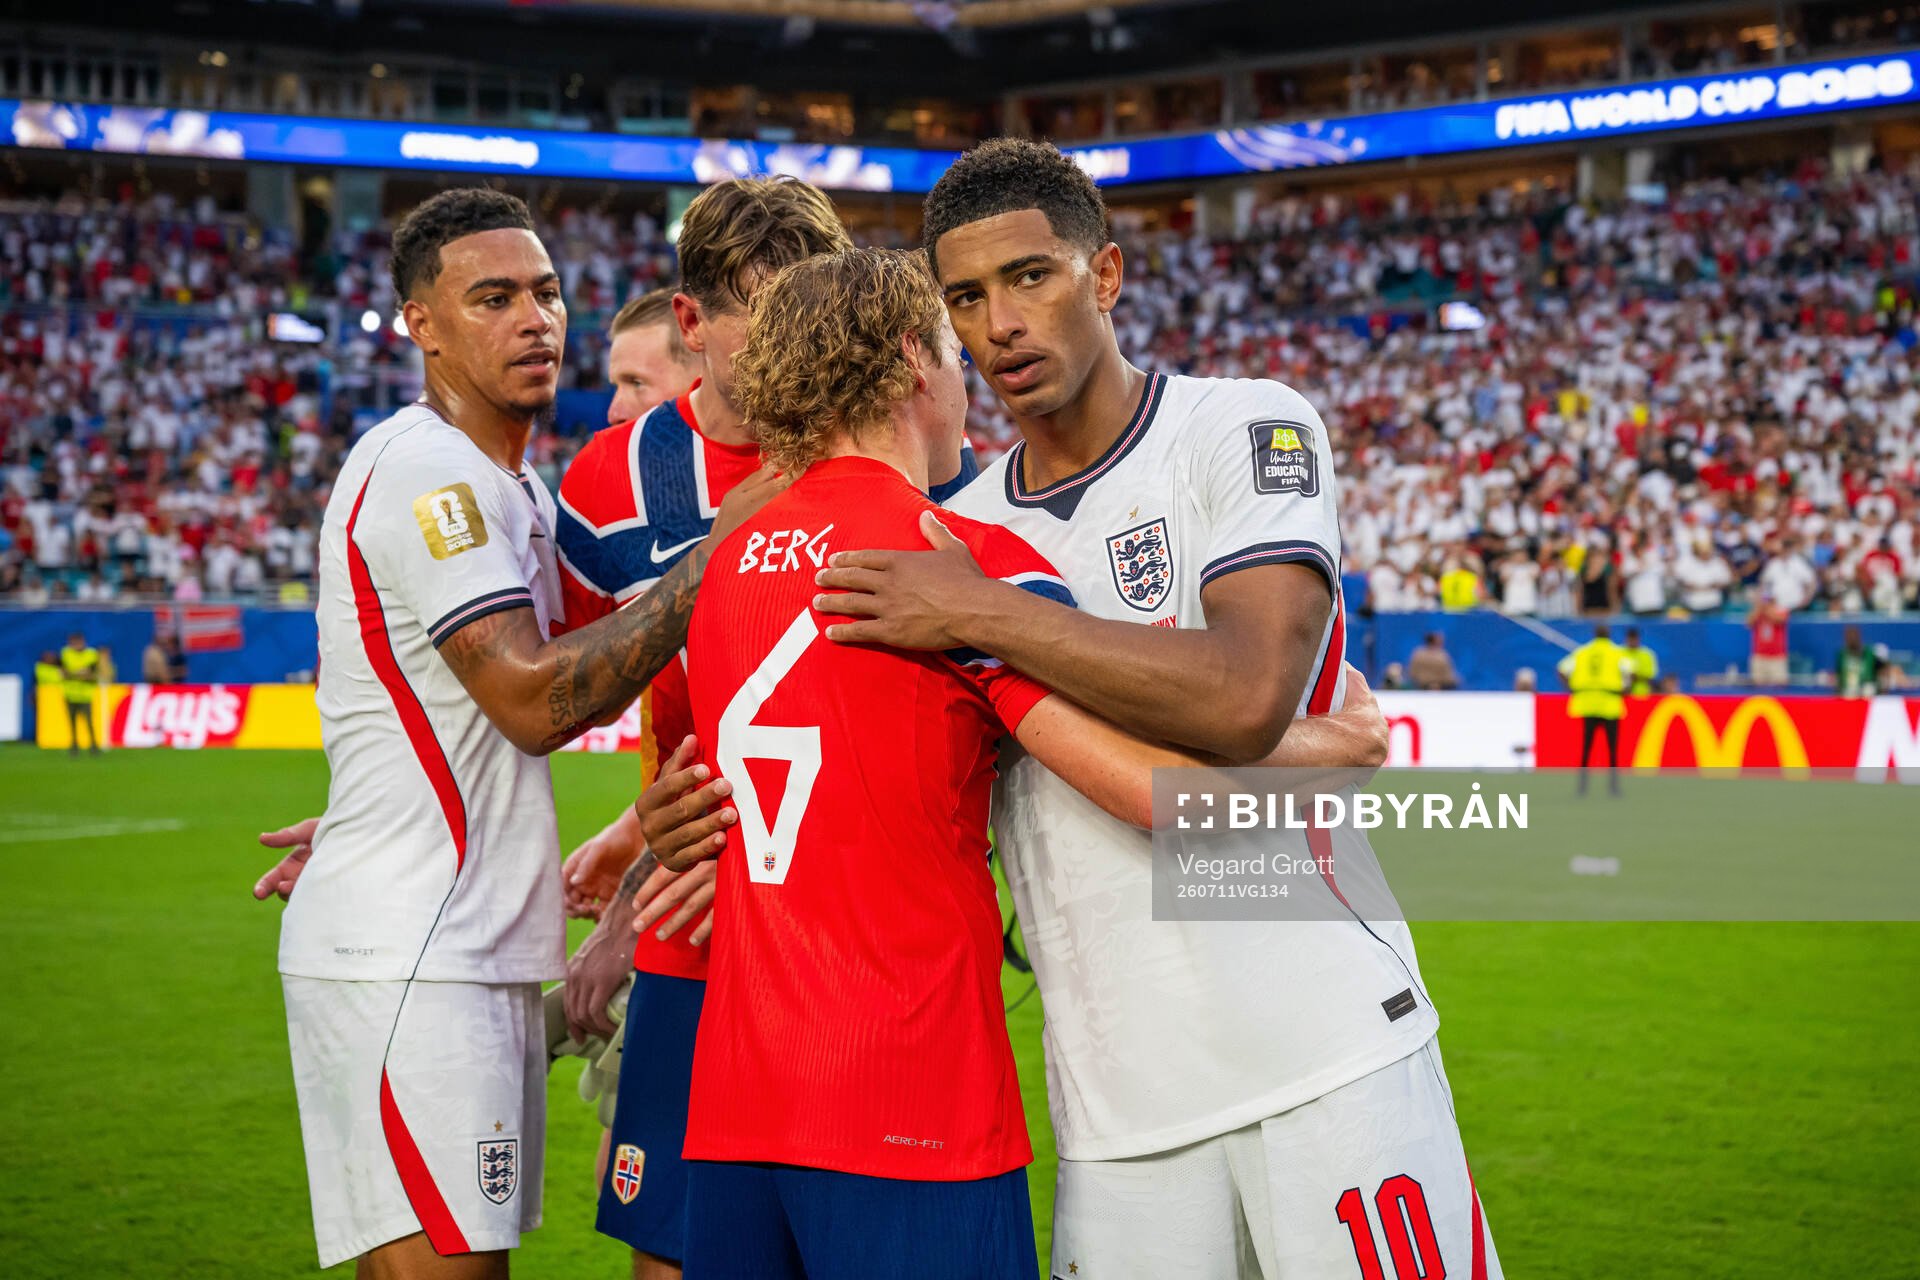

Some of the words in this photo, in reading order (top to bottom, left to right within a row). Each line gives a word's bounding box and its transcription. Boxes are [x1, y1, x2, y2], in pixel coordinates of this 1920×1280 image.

[1495, 100, 1571, 139] FIFA
[1571, 86, 1699, 130] WORLD
[1700, 76, 1776, 116] CUP
[1281, 477, 1300, 485] FIFA
[738, 523, 834, 574] BERG
[716, 606, 822, 885] 6
[883, 1134, 944, 1150] AERO-FIT
[1335, 1173, 1447, 1280] 10
